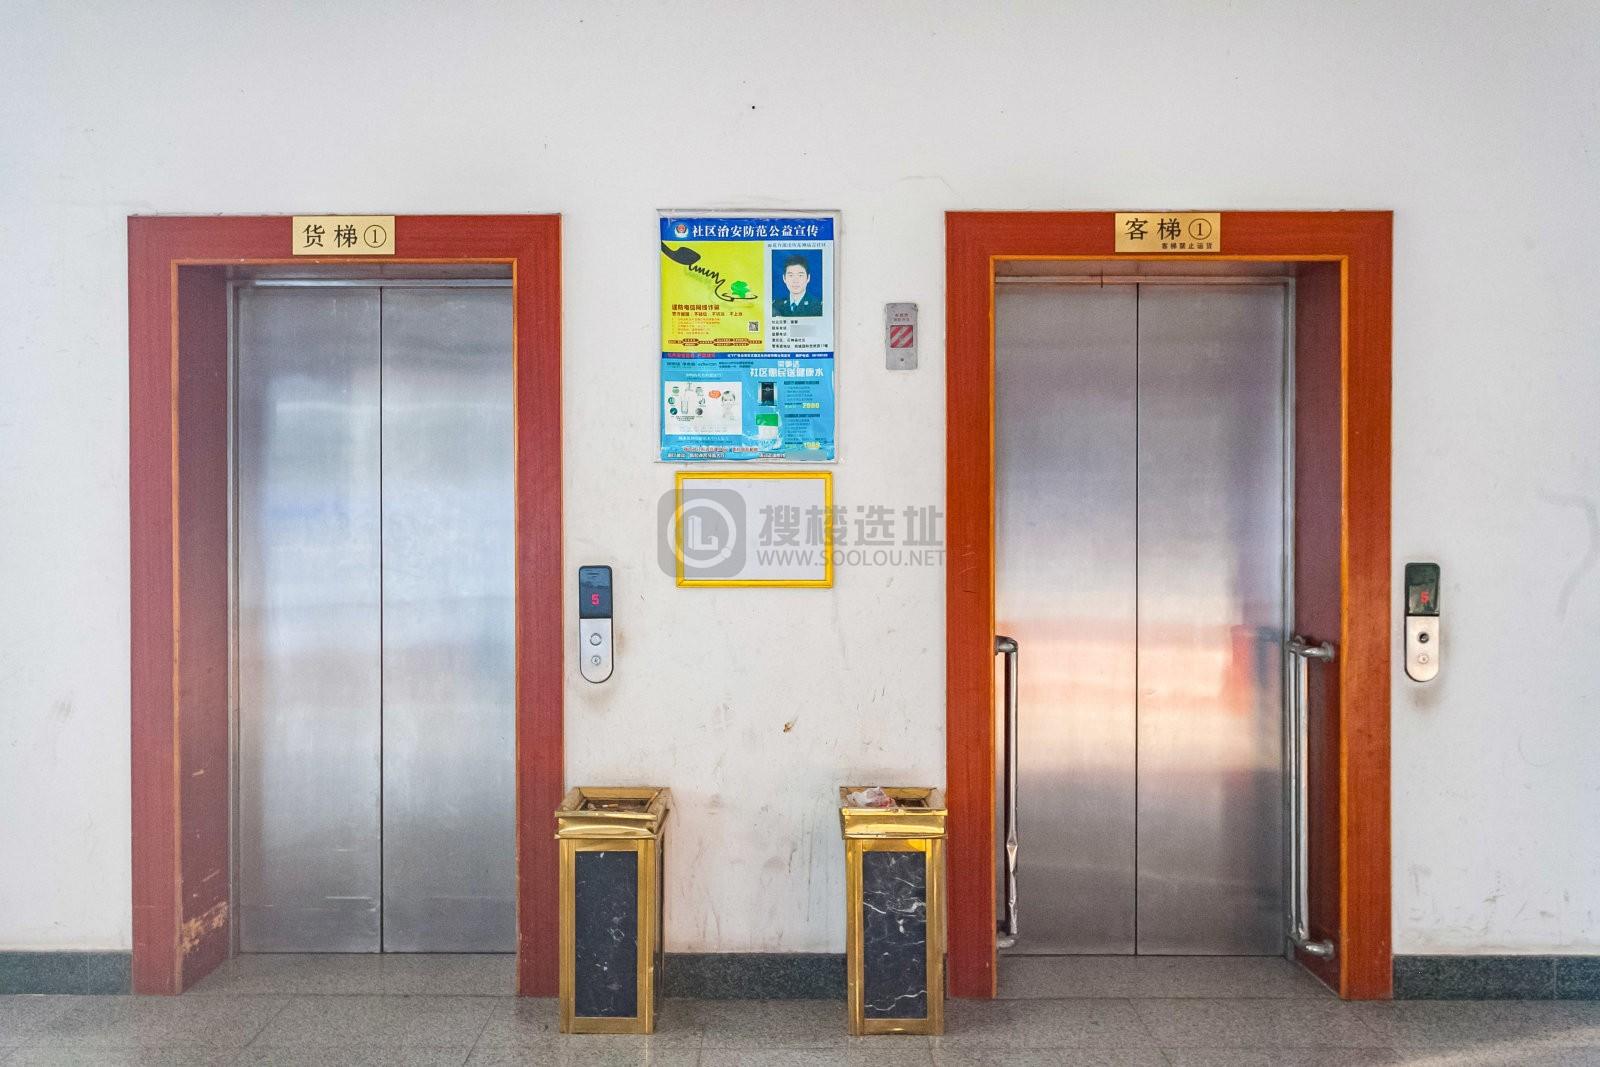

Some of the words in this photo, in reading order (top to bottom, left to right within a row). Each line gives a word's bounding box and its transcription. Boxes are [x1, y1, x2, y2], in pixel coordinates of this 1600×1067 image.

[692, 224, 819, 238] 社区治安防范公益宣传
[1161, 242, 1213, 250] 客梯禁止运货
[591, 593, 600, 606] 5
[1421, 591, 1430, 604] 5
